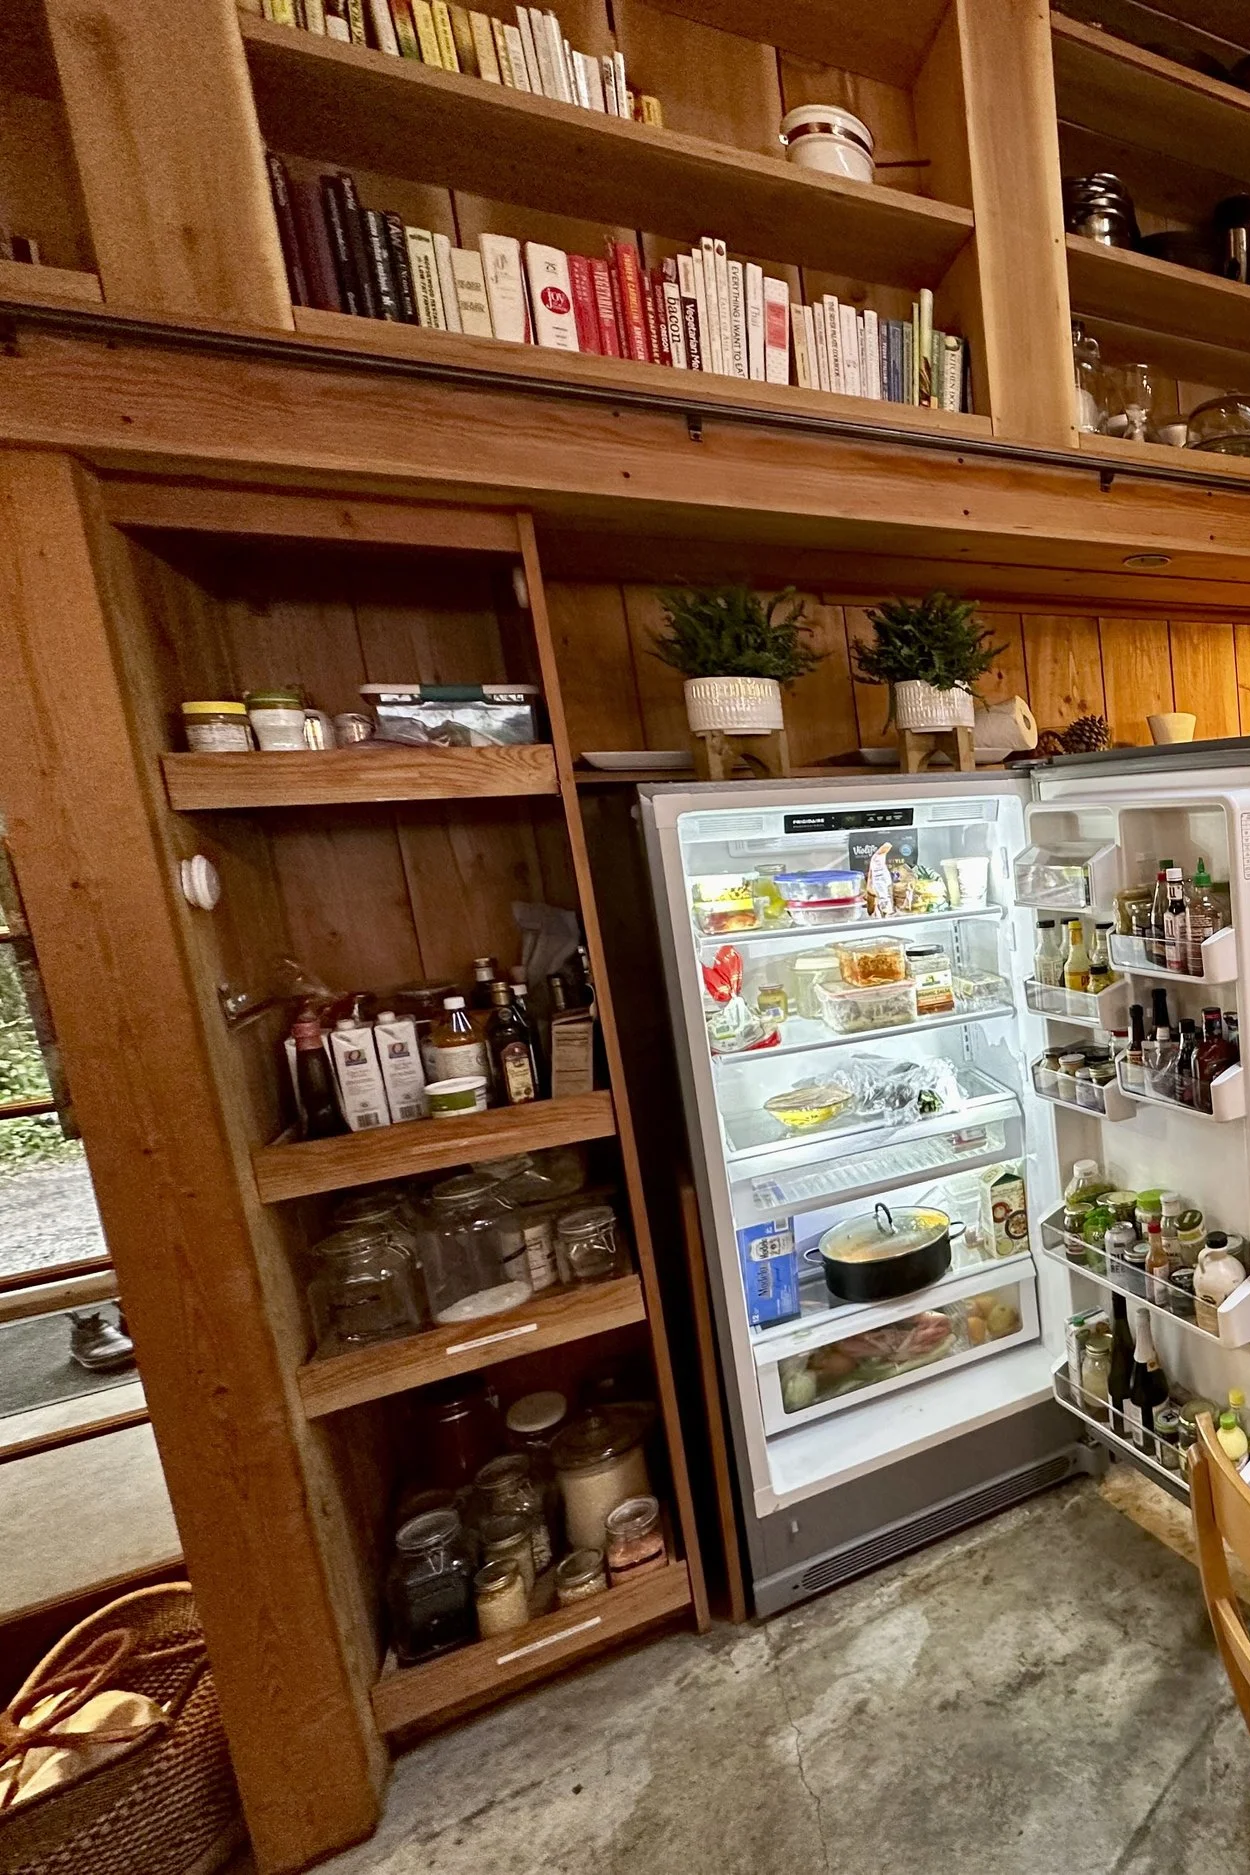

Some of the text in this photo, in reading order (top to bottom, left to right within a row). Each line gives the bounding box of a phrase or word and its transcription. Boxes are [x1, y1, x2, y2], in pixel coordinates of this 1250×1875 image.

[386, 213, 405, 249] RAW
[594, 271, 614, 320] VEGETARIAN
[731, 266, 740, 317] EVERYTHING
[667, 297, 681, 343] bacon
[685, 304, 698, 354] Vegetarian
[733, 324, 742, 350] WANT
[660, 323, 669, 353] OREGON
[734, 350, 742, 361] TO
[735, 362, 746, 377] EAT
[949, 353, 957, 388] KITCHEN
[757, 1265, 769, 1297] Modelo
